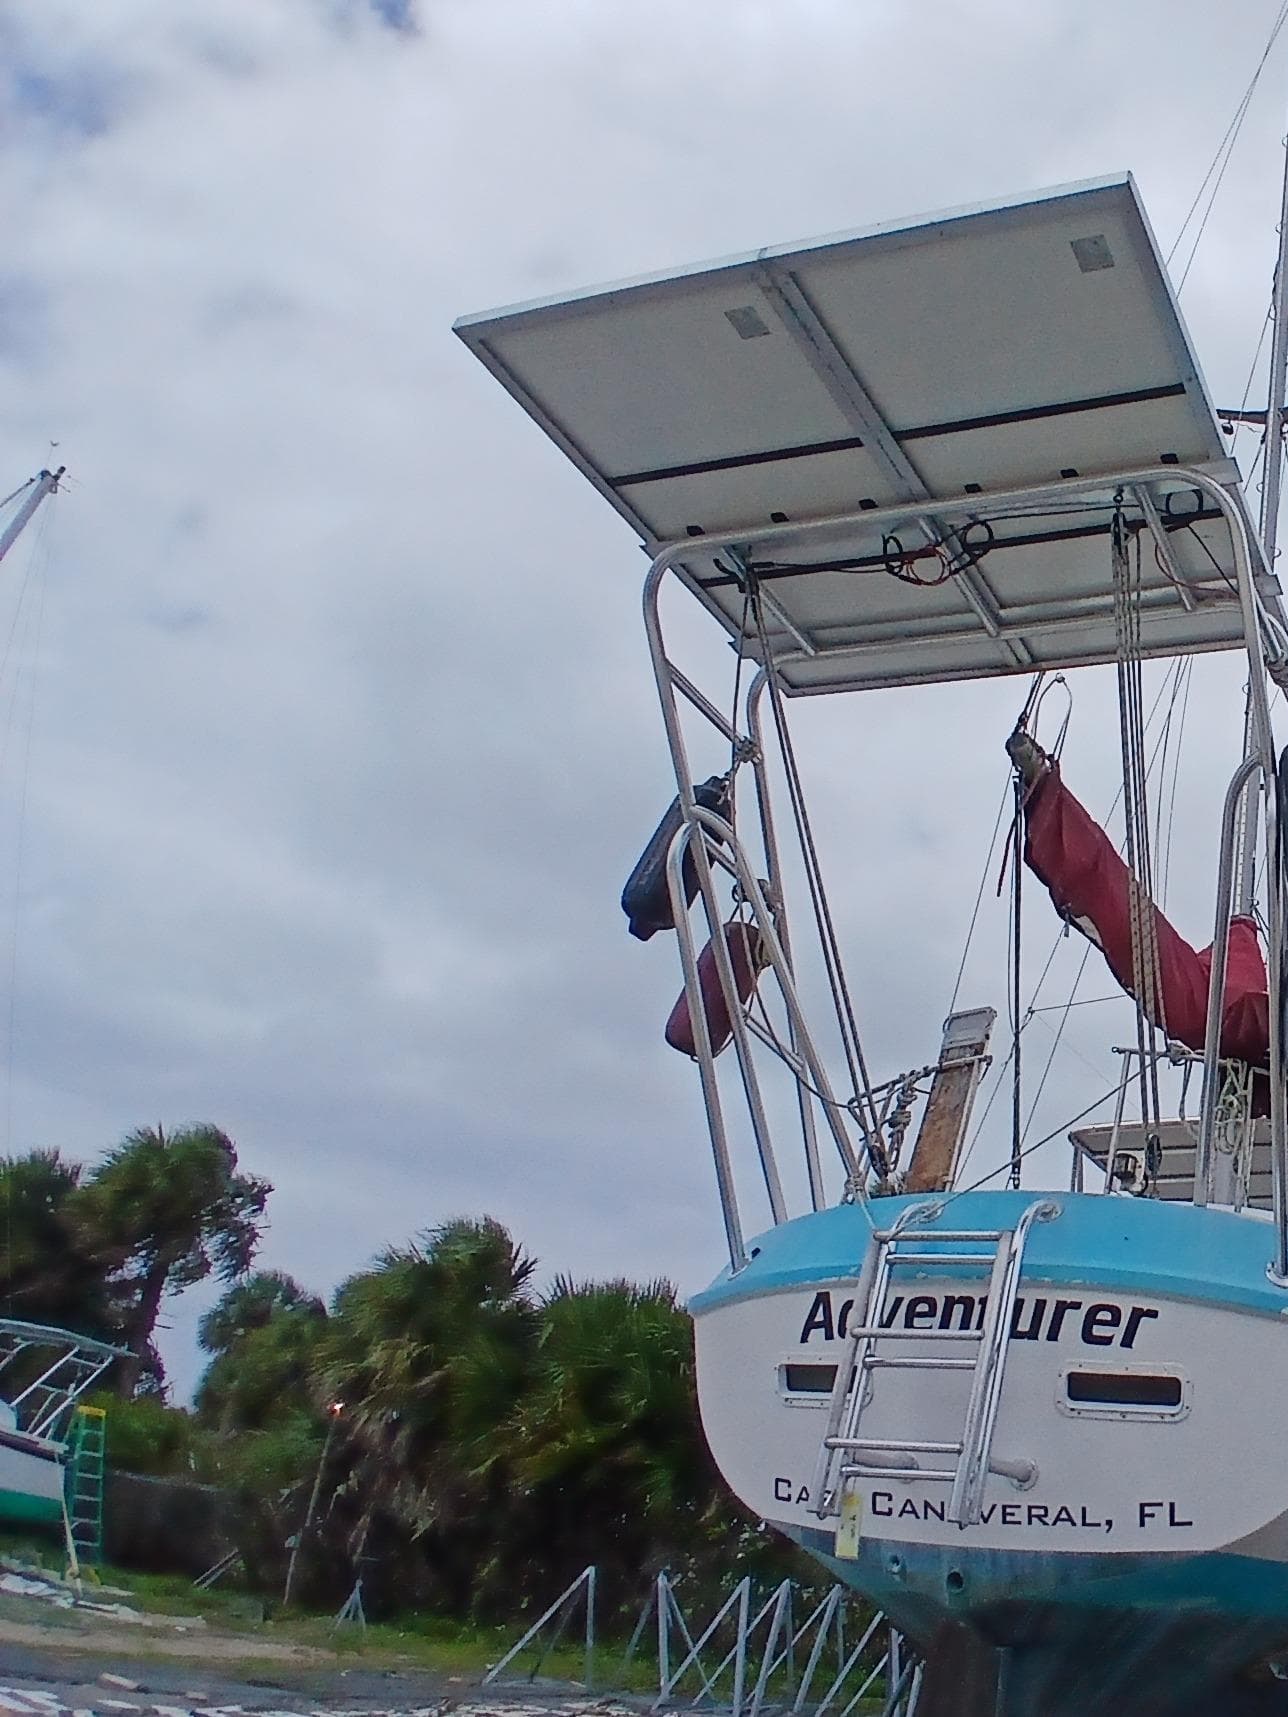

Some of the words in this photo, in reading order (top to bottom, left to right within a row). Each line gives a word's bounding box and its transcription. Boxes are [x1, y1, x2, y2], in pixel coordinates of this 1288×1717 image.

[774, 1477, 840, 1506] CA
[871, 1491, 1114, 1533] CANVERAL,
[1138, 1501, 1194, 1528] FL
